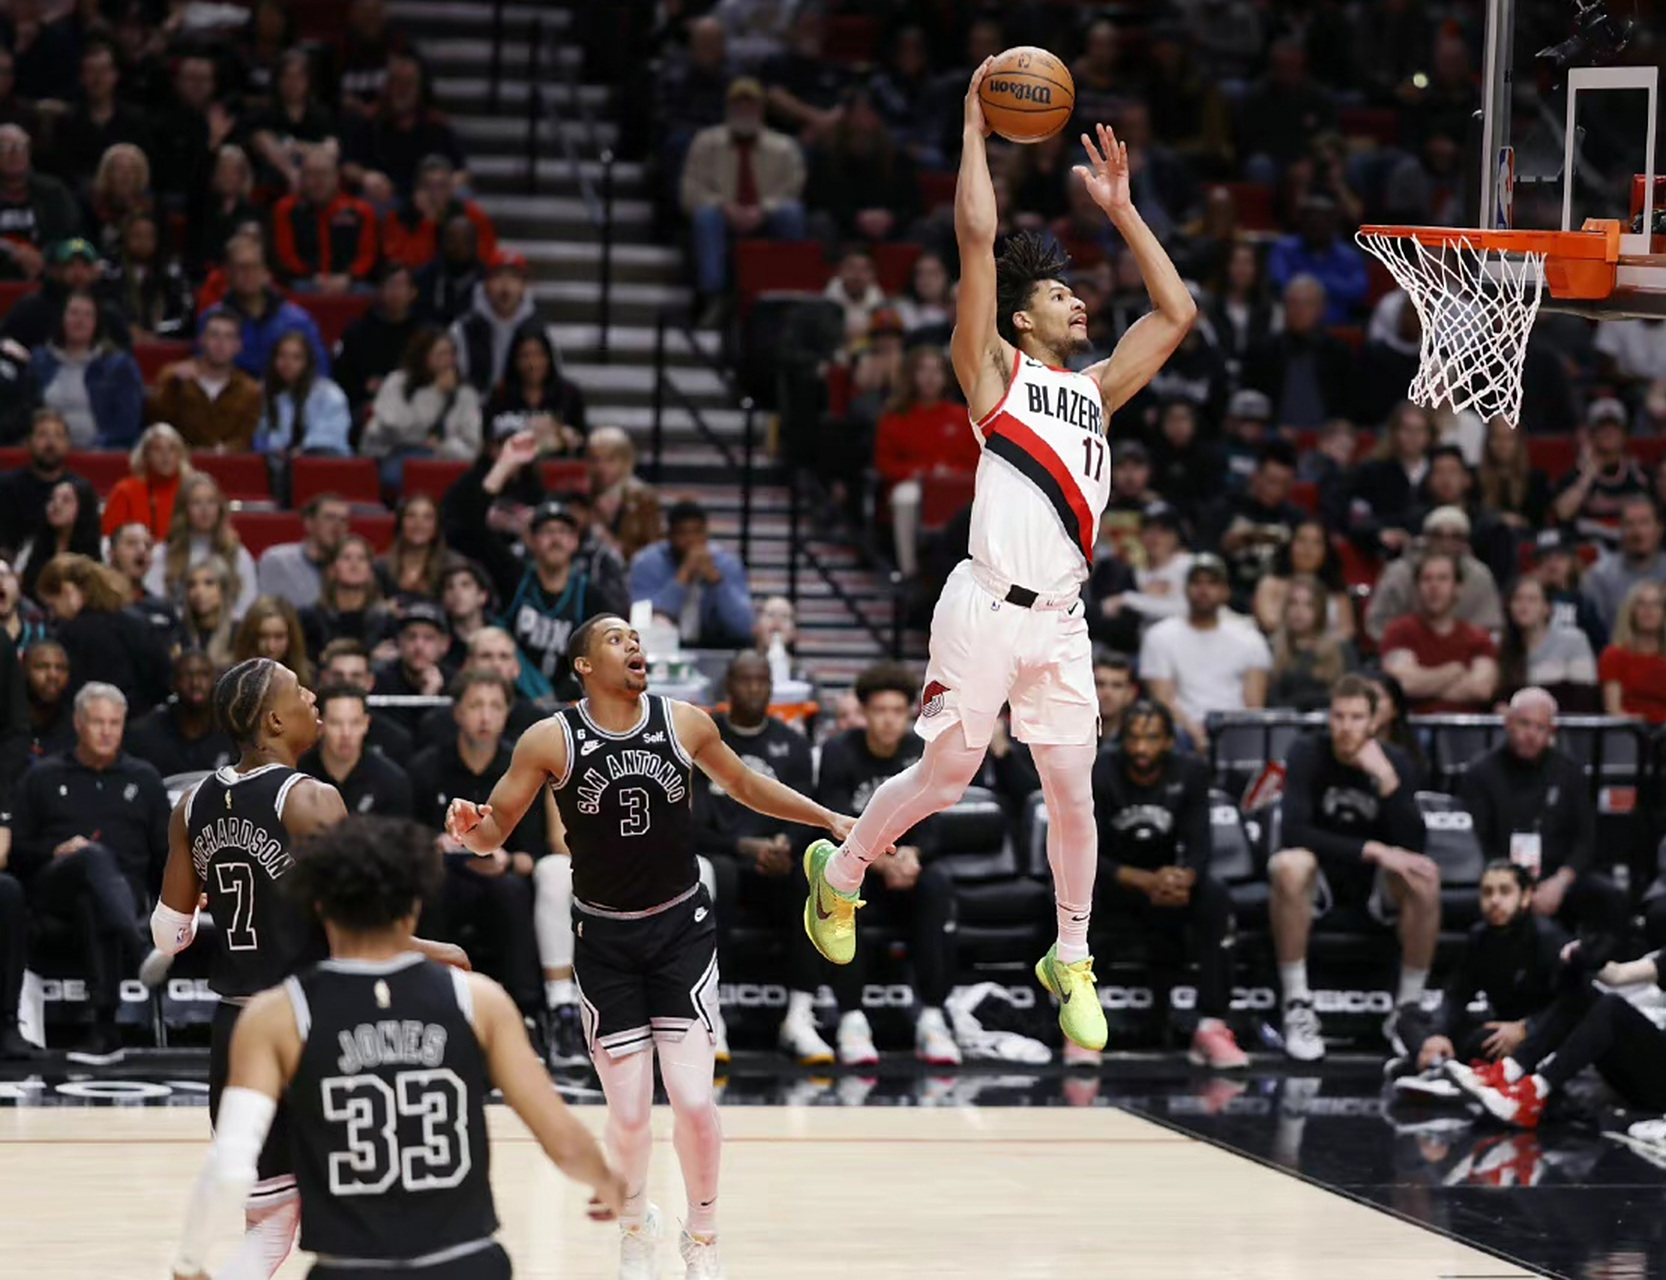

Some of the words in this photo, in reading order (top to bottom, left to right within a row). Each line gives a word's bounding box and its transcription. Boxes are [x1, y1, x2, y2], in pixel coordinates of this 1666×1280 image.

[990, 80, 1051, 104] Wilson
[1083, 436, 1104, 482] 17
[577, 728, 586, 739] 6
[577, 766, 610, 814] SAN
[606, 749, 686, 804] ANTONIO
[619, 787, 651, 837] 3
[215, 861, 258, 950] 7
[337, 1019, 448, 1075] JONES
[321, 1067, 472, 1196] 33
